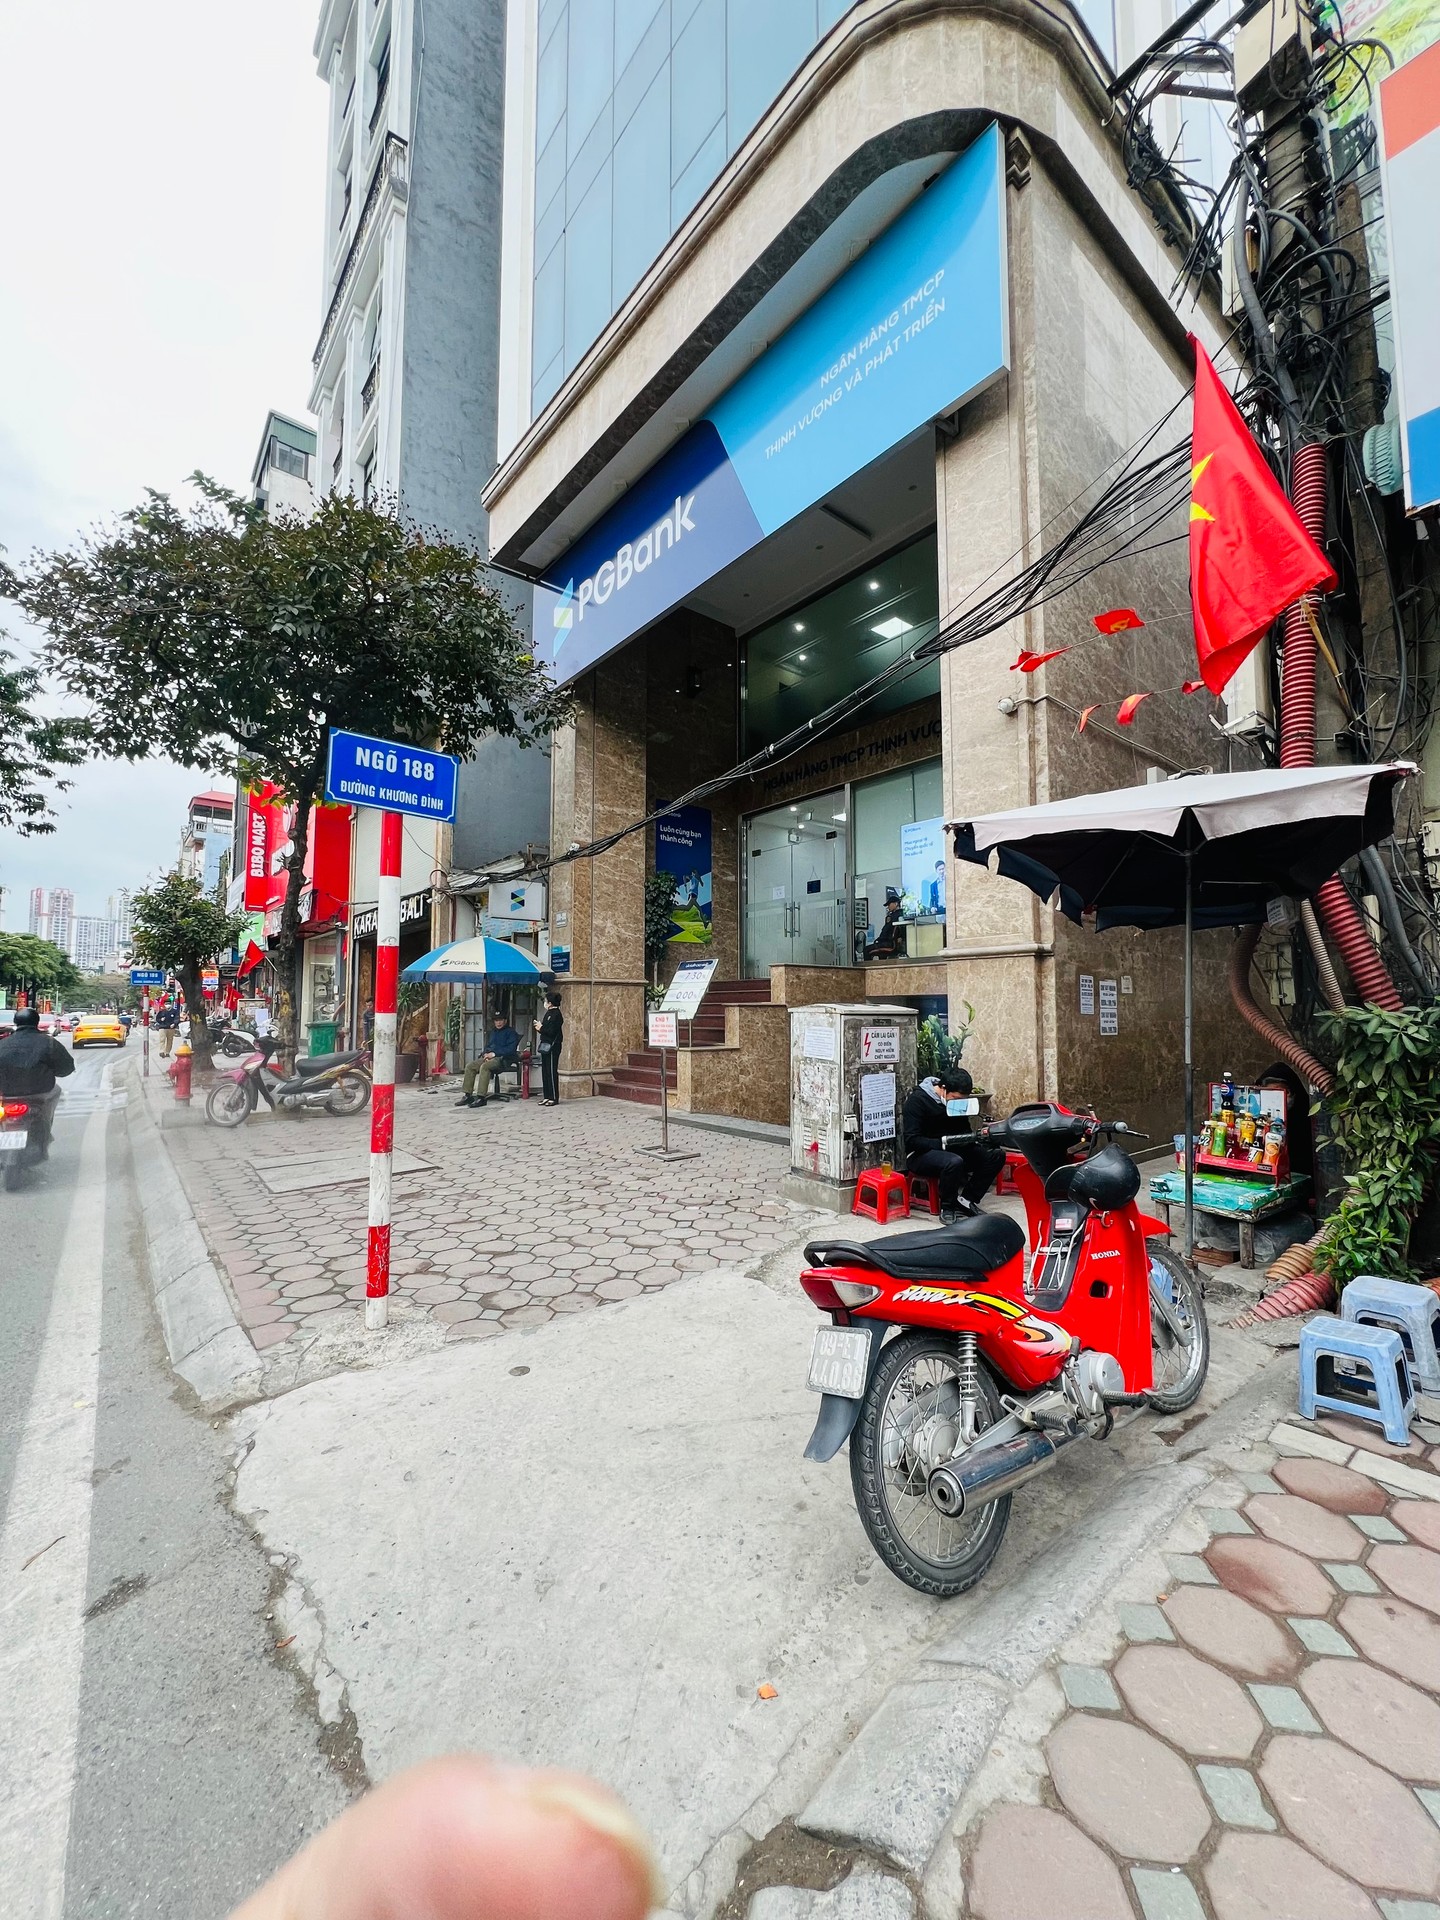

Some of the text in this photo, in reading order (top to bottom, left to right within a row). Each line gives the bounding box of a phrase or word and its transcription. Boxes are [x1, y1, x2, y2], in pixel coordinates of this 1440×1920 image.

[820, 269, 945, 389] NGÂN HÀNG TMCP
[764, 297, 946, 460] THỊNH VƯỢNG VÀ PHÁT TRIỂN
[578, 494, 696, 622] PGBank
[355, 746, 435, 782] NGÕ 188
[795, 759, 828, 782] HÀNG
[830, 748, 866, 769] TMCP
[868, 731, 908, 755] THỊNH
[911, 719, 942, 743] VƯỢ
[340, 779, 444, 811] ĐƯỜNG KHƯƠNG ĐÌNH
[251, 812, 267, 878] BIBO MART
[660, 824, 702, 839] Luôn cùng bạn
[660, 834, 693, 847] thành công
[400, 894, 426, 923] BALI
[864, 1113, 872, 1121] CHO
[1090, 1249, 1121, 1260] HONDA
